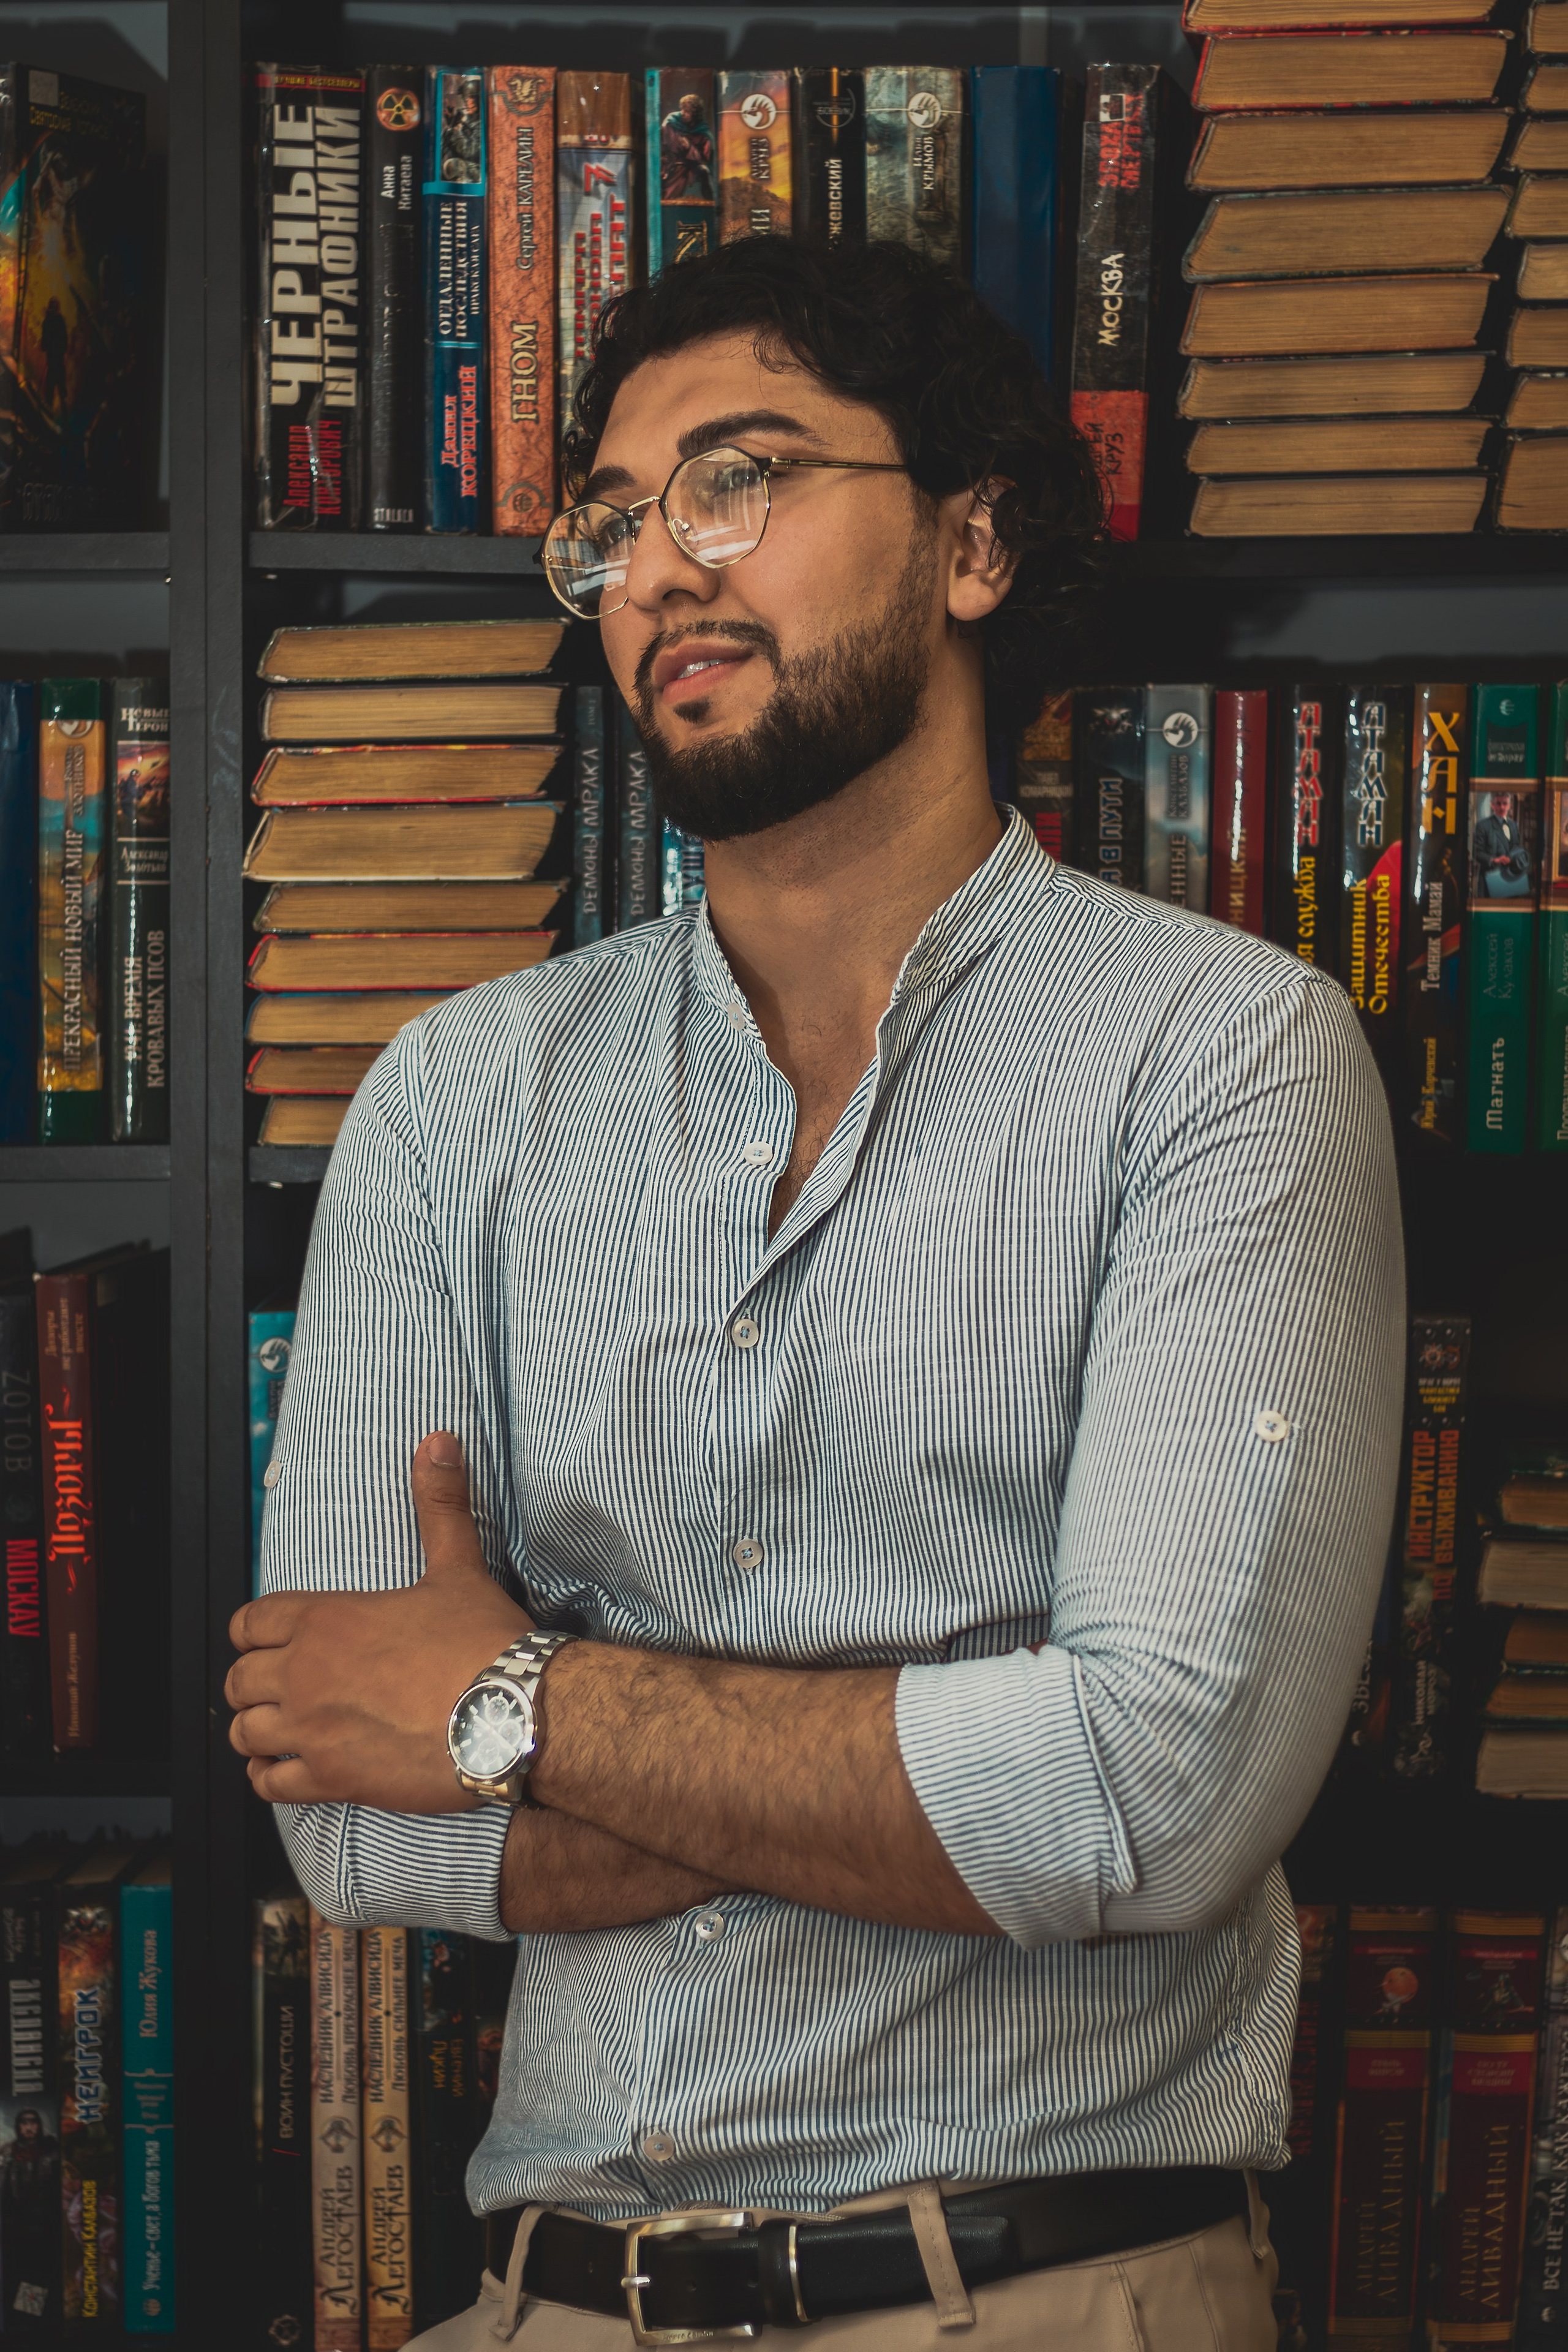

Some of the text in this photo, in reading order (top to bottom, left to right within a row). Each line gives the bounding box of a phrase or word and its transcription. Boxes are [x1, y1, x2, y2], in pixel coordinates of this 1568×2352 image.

[381, 165, 396, 198] Анна
[516, 127, 535, 268] Сергей КАРЕЛИН
[824, 158, 843, 238] жевский
[921, 135, 935, 189] КРЫМОВ
[271, 104, 322, 405] ЧЕРНЫЕ
[315, 107, 361, 407] ШТРАФНИКИ
[438, 201, 454, 334] ОТДАЛЕННЫЕ
[453, 200, 469, 337] ПОСЛЕДСТВИЯ
[1098, 252, 1125, 345] МОСКВА
[458, 365, 480, 497] КОРЕЦКИЙ
[510, 320, 538, 422] ГНОМ
[1103, 432, 1123, 475] КРУЗ
[581, 747, 599, 913] ДЕМОНЫ МРАКА
[628, 750, 647, 916] ДЕМОНЫ МРАКА
[1098, 777, 1123, 840] ПУТИ
[1294, 701, 1322, 846] АТАМАН
[1355, 699, 1387, 846] АТАМАН
[1421, 711, 1460, 835] ХАН
[1170, 834, 1186, 906] ЕННЫЕ
[1294, 856, 1327, 937] служба
[59, 829, 84, 1070] ПРЕКРАСНЫЙ НОВЫЙ МИР
[1348, 877, 1370, 1009] Защитник
[1369, 875, 1392, 1014] Отечества
[1420, 881, 1444, 992] Темник Мамай
[1483, 933, 1499, 998] Алексей
[1498, 937, 1515, 999] Кулаков
[146, 930, 165, 1087] КРОВАВЫХ ПСОВ
[1421, 1038, 1439, 1095] Корчевский
[1486, 1038, 1506, 1131] Магнатъ
[44, 1404, 94, 1564] Дозоры
[1408, 1430, 1436, 1557] ИНСТРУКТОР
[1437, 1429, 1460, 1564] ВЫЖИВАНИЮ
[6, 1537, 41, 1637] МОСКАУ
[138, 1929, 159, 2038] Юлия Жукова
[318, 1932, 333, 2103] НАСЛЕДНИК АЛВИСИДА
[341, 1928, 358, 2105] ЛЮБОВЬ ПРЕКРАСНЕЕ МЕЧА
[368, 1932, 384, 2103] НАСЛЕДНИК АЛВИСИДА
[391, 1936, 406, 2092] ЛЮБОВЬ СИЛЬНЕЕ МЕЧА
[72, 1986, 104, 2122] НЕИГРОК
[279, 2005, 296, 2139] ВОИН ПУСТОШИ
[141, 2251, 162, 2291] Ученье
[318, 2188, 336, 2266] АНДРЕЙ
[322, 2165, 359, 2315] ЛЕГОСТАЕВ
[369, 2187, 386, 2266] АНДРЕЙ
[372, 2165, 410, 2314] ЛЕГОСТАЕВ
[1355, 2201, 1376, 2294] АНДРЕЙ
[1379, 2120, 1406, 2303] ЛИВАДНЫЙ
[1458, 2206, 1481, 2301] АНДРЕЙ
[1481, 2124, 1511, 2309] ЛИВАДНЫЙ
[1542, 2257, 1562, 2290] ВСЕ
[1546, 2226, 1564, 2250] НЕ
